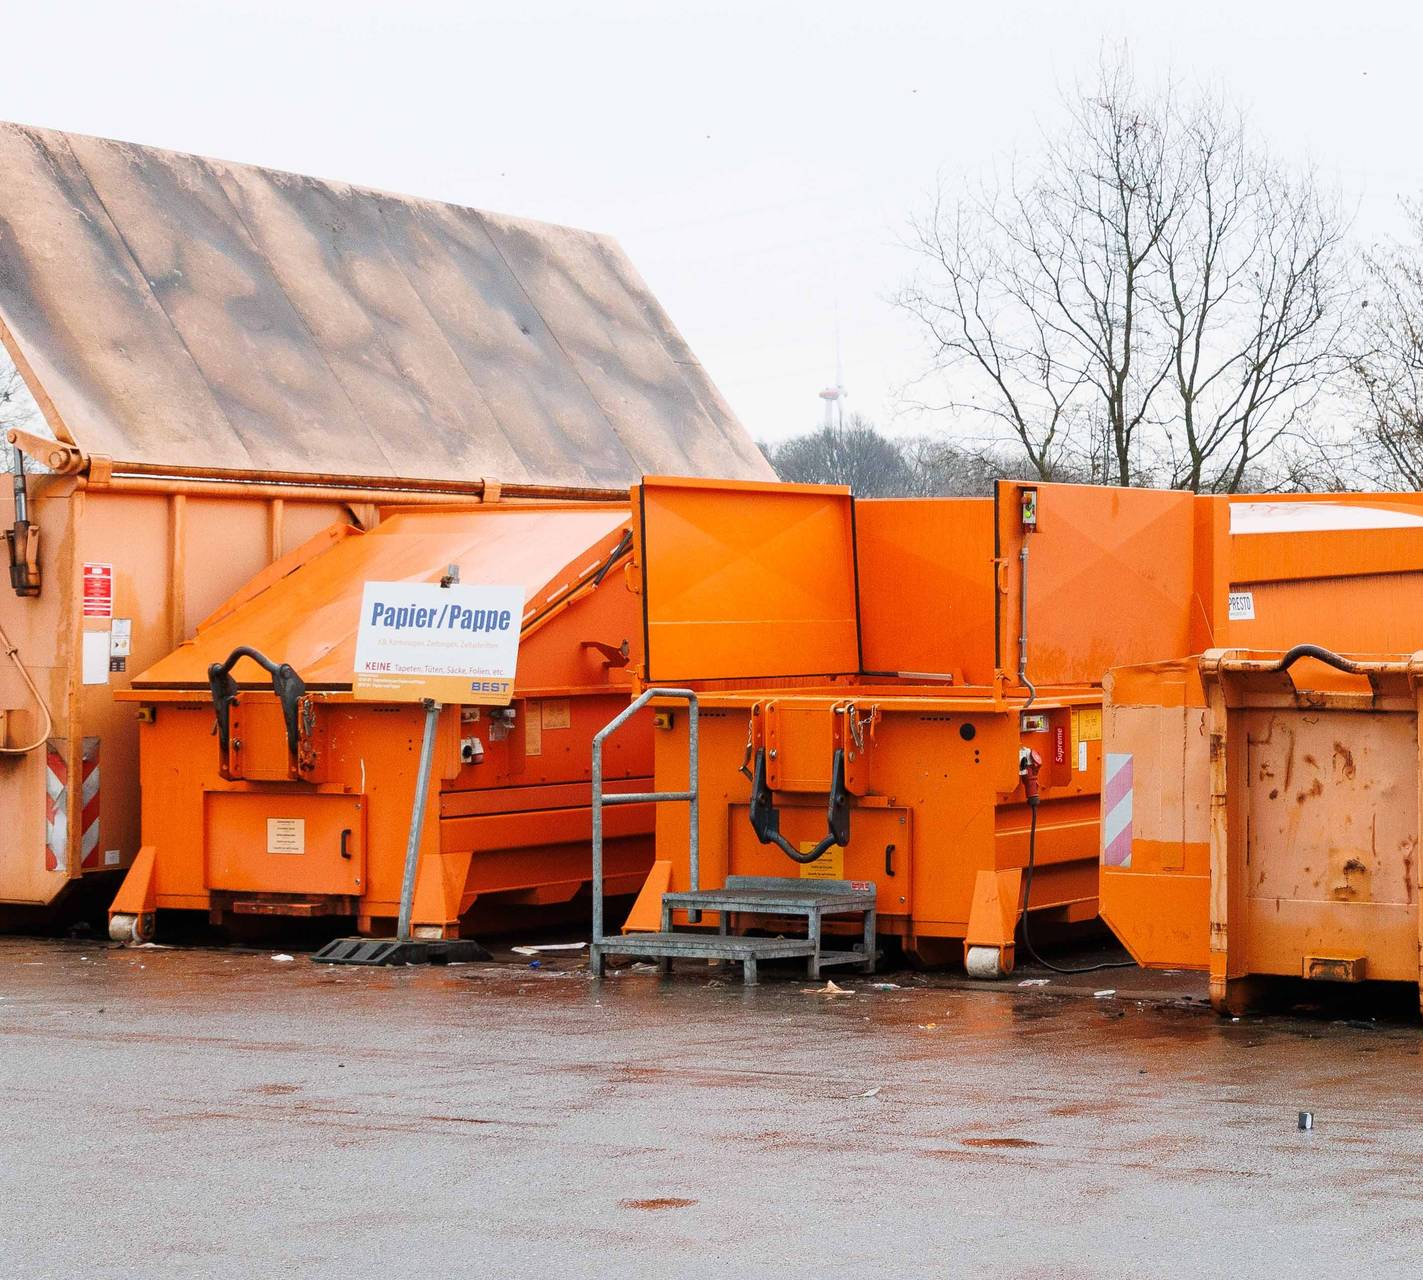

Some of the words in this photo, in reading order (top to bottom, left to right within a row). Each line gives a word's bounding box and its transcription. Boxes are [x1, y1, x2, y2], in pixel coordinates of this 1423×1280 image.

[371, 602, 511, 632] Papier/Pappe
[365, 662, 391, 671] KEINE
[472, 682, 510, 692] BEST
[1056, 728, 1064, 762] Supreme
